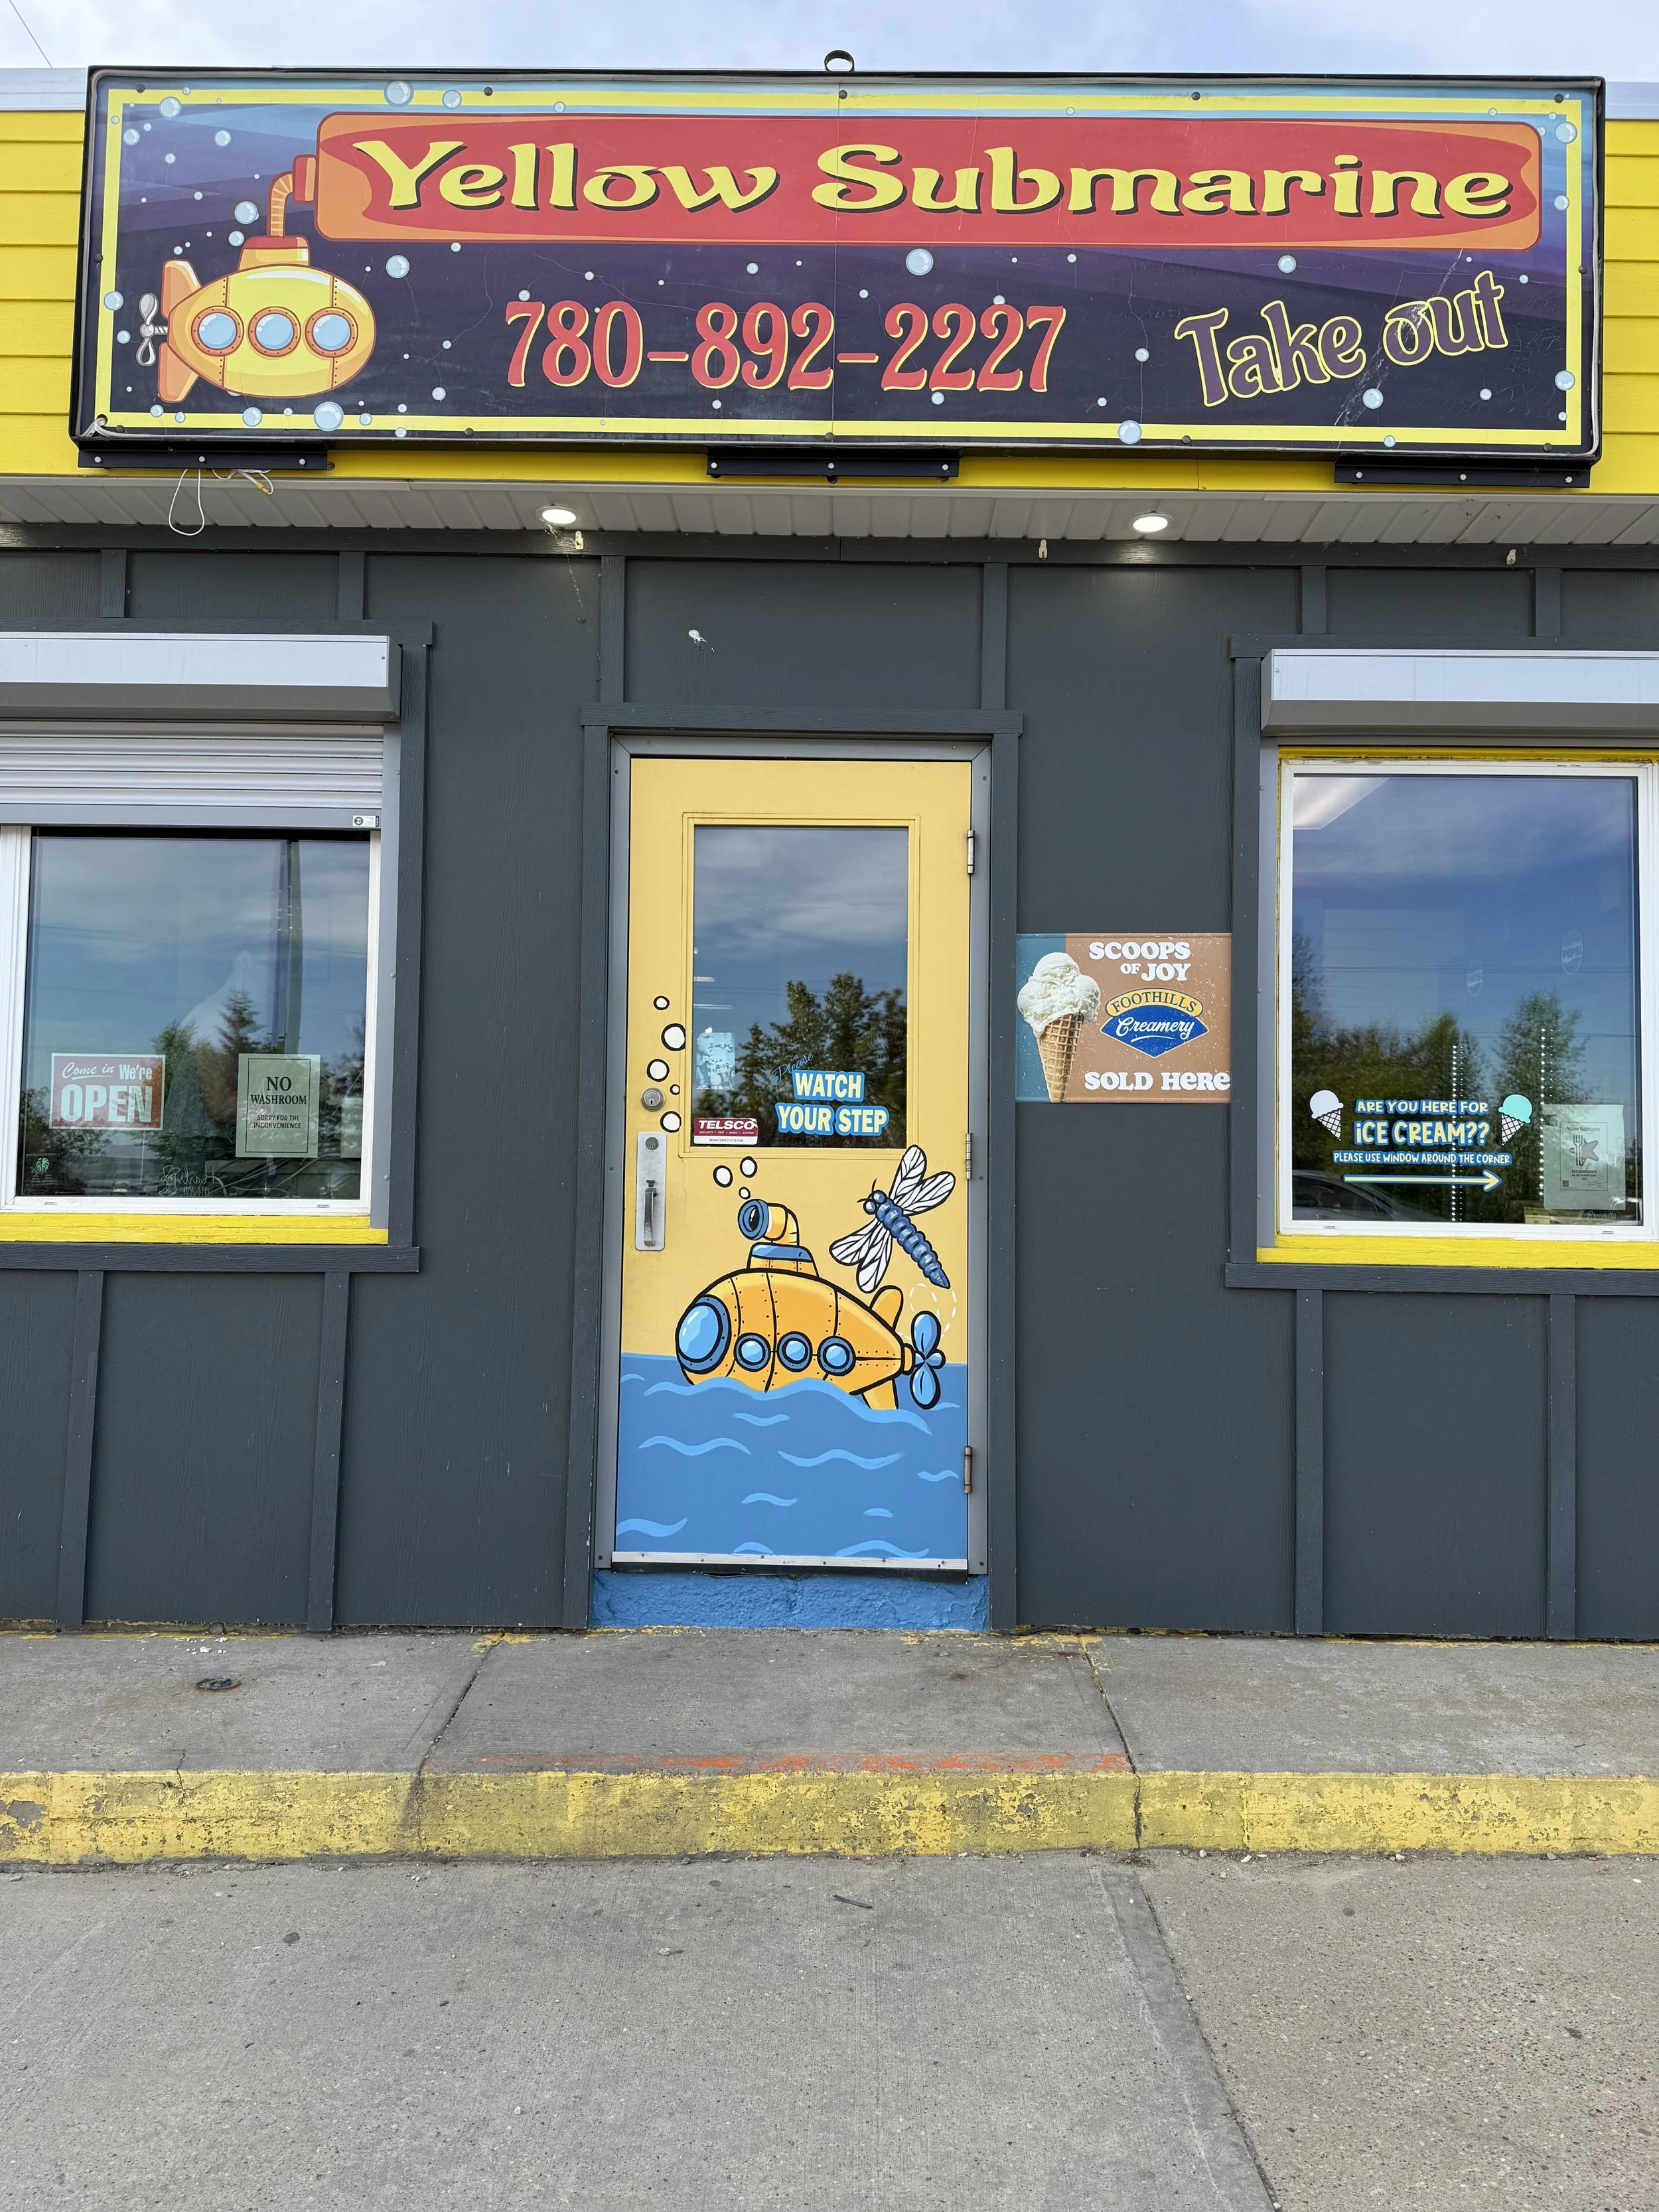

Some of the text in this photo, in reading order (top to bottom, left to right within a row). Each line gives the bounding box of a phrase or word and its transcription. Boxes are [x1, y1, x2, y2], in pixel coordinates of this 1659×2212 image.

[352, 140, 1514, 219] Yellow Submarine
[505, 300, 1066, 393] 780-892-2227
[1174, 270, 1508, 407] Take out
[1089, 942, 1190, 960] SCOOPS
[1562, 946, 1582, 960] PEPSI
[1120, 963, 1191, 982] OF JOY
[1112, 992, 1197, 1013] FOOTHILLS
[1116, 1017, 1196, 1040] Creamery
[62, 1062, 153, 1080] Come in We're
[770, 1053, 814, 1086] Please
[266, 1076, 292, 1091] NO
[794, 1072, 862, 1099] WATCH
[1084, 1072, 1153, 1090] SOLD
[60, 1084, 153, 1123] OPEN
[250, 1094, 307, 1105] WASHROOM
[1357, 1100, 1488, 1113] ARE YOU HERE FOR
[698, 1120, 755, 1130] TELSCO
[777, 1104, 888, 1134] YOUR STEP
[1394, 1121, 1490, 1145] CREAM??
[1333, 1152, 1363, 1163] PLEASE
[1365, 1153, 1380, 1163] USE
[1421, 1153, 1457, 1163] AROUND
[1459, 1153, 1474, 1163] THE
[1477, 1153, 1510, 1164] CORNER
